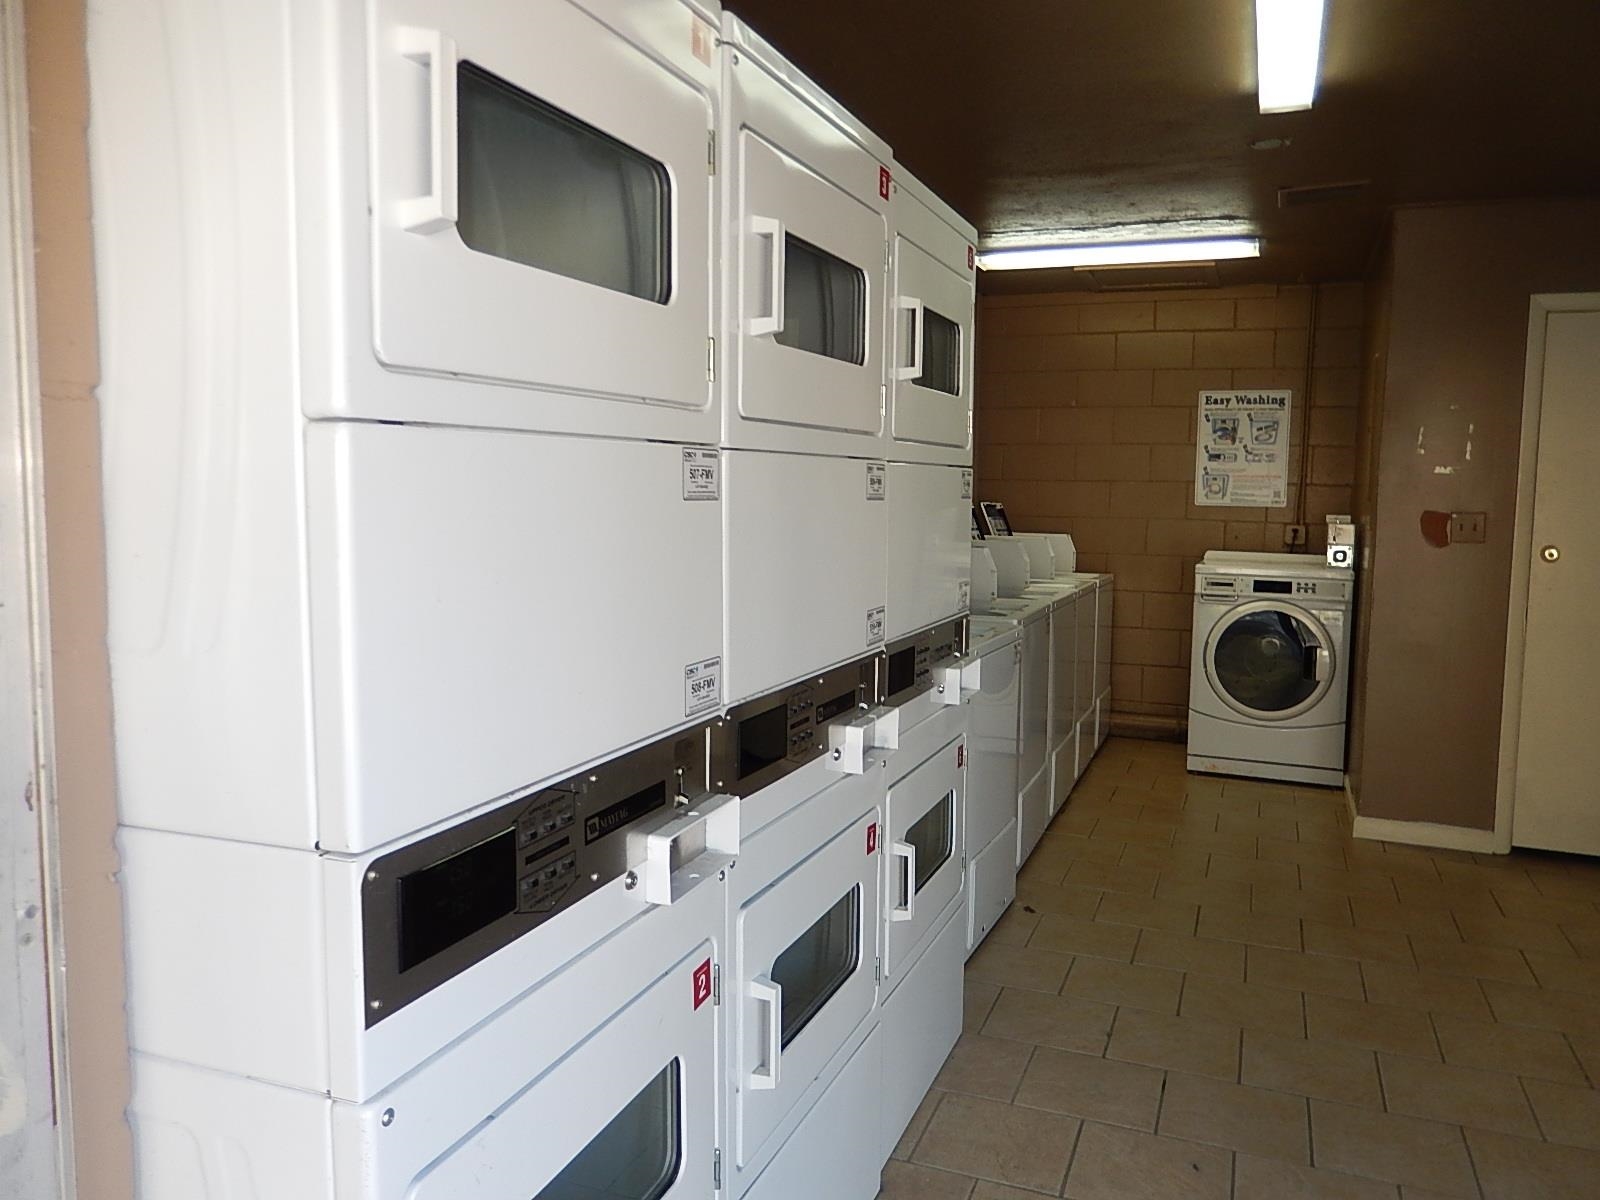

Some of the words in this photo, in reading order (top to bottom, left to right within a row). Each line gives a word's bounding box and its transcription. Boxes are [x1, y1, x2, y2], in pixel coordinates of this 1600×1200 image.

[1205, 395, 1231, 408] Easy
[1234, 394, 1286, 408] Washing
[690, 468, 714, 480] 507-FMV
[698, 973, 707, 999] 2
